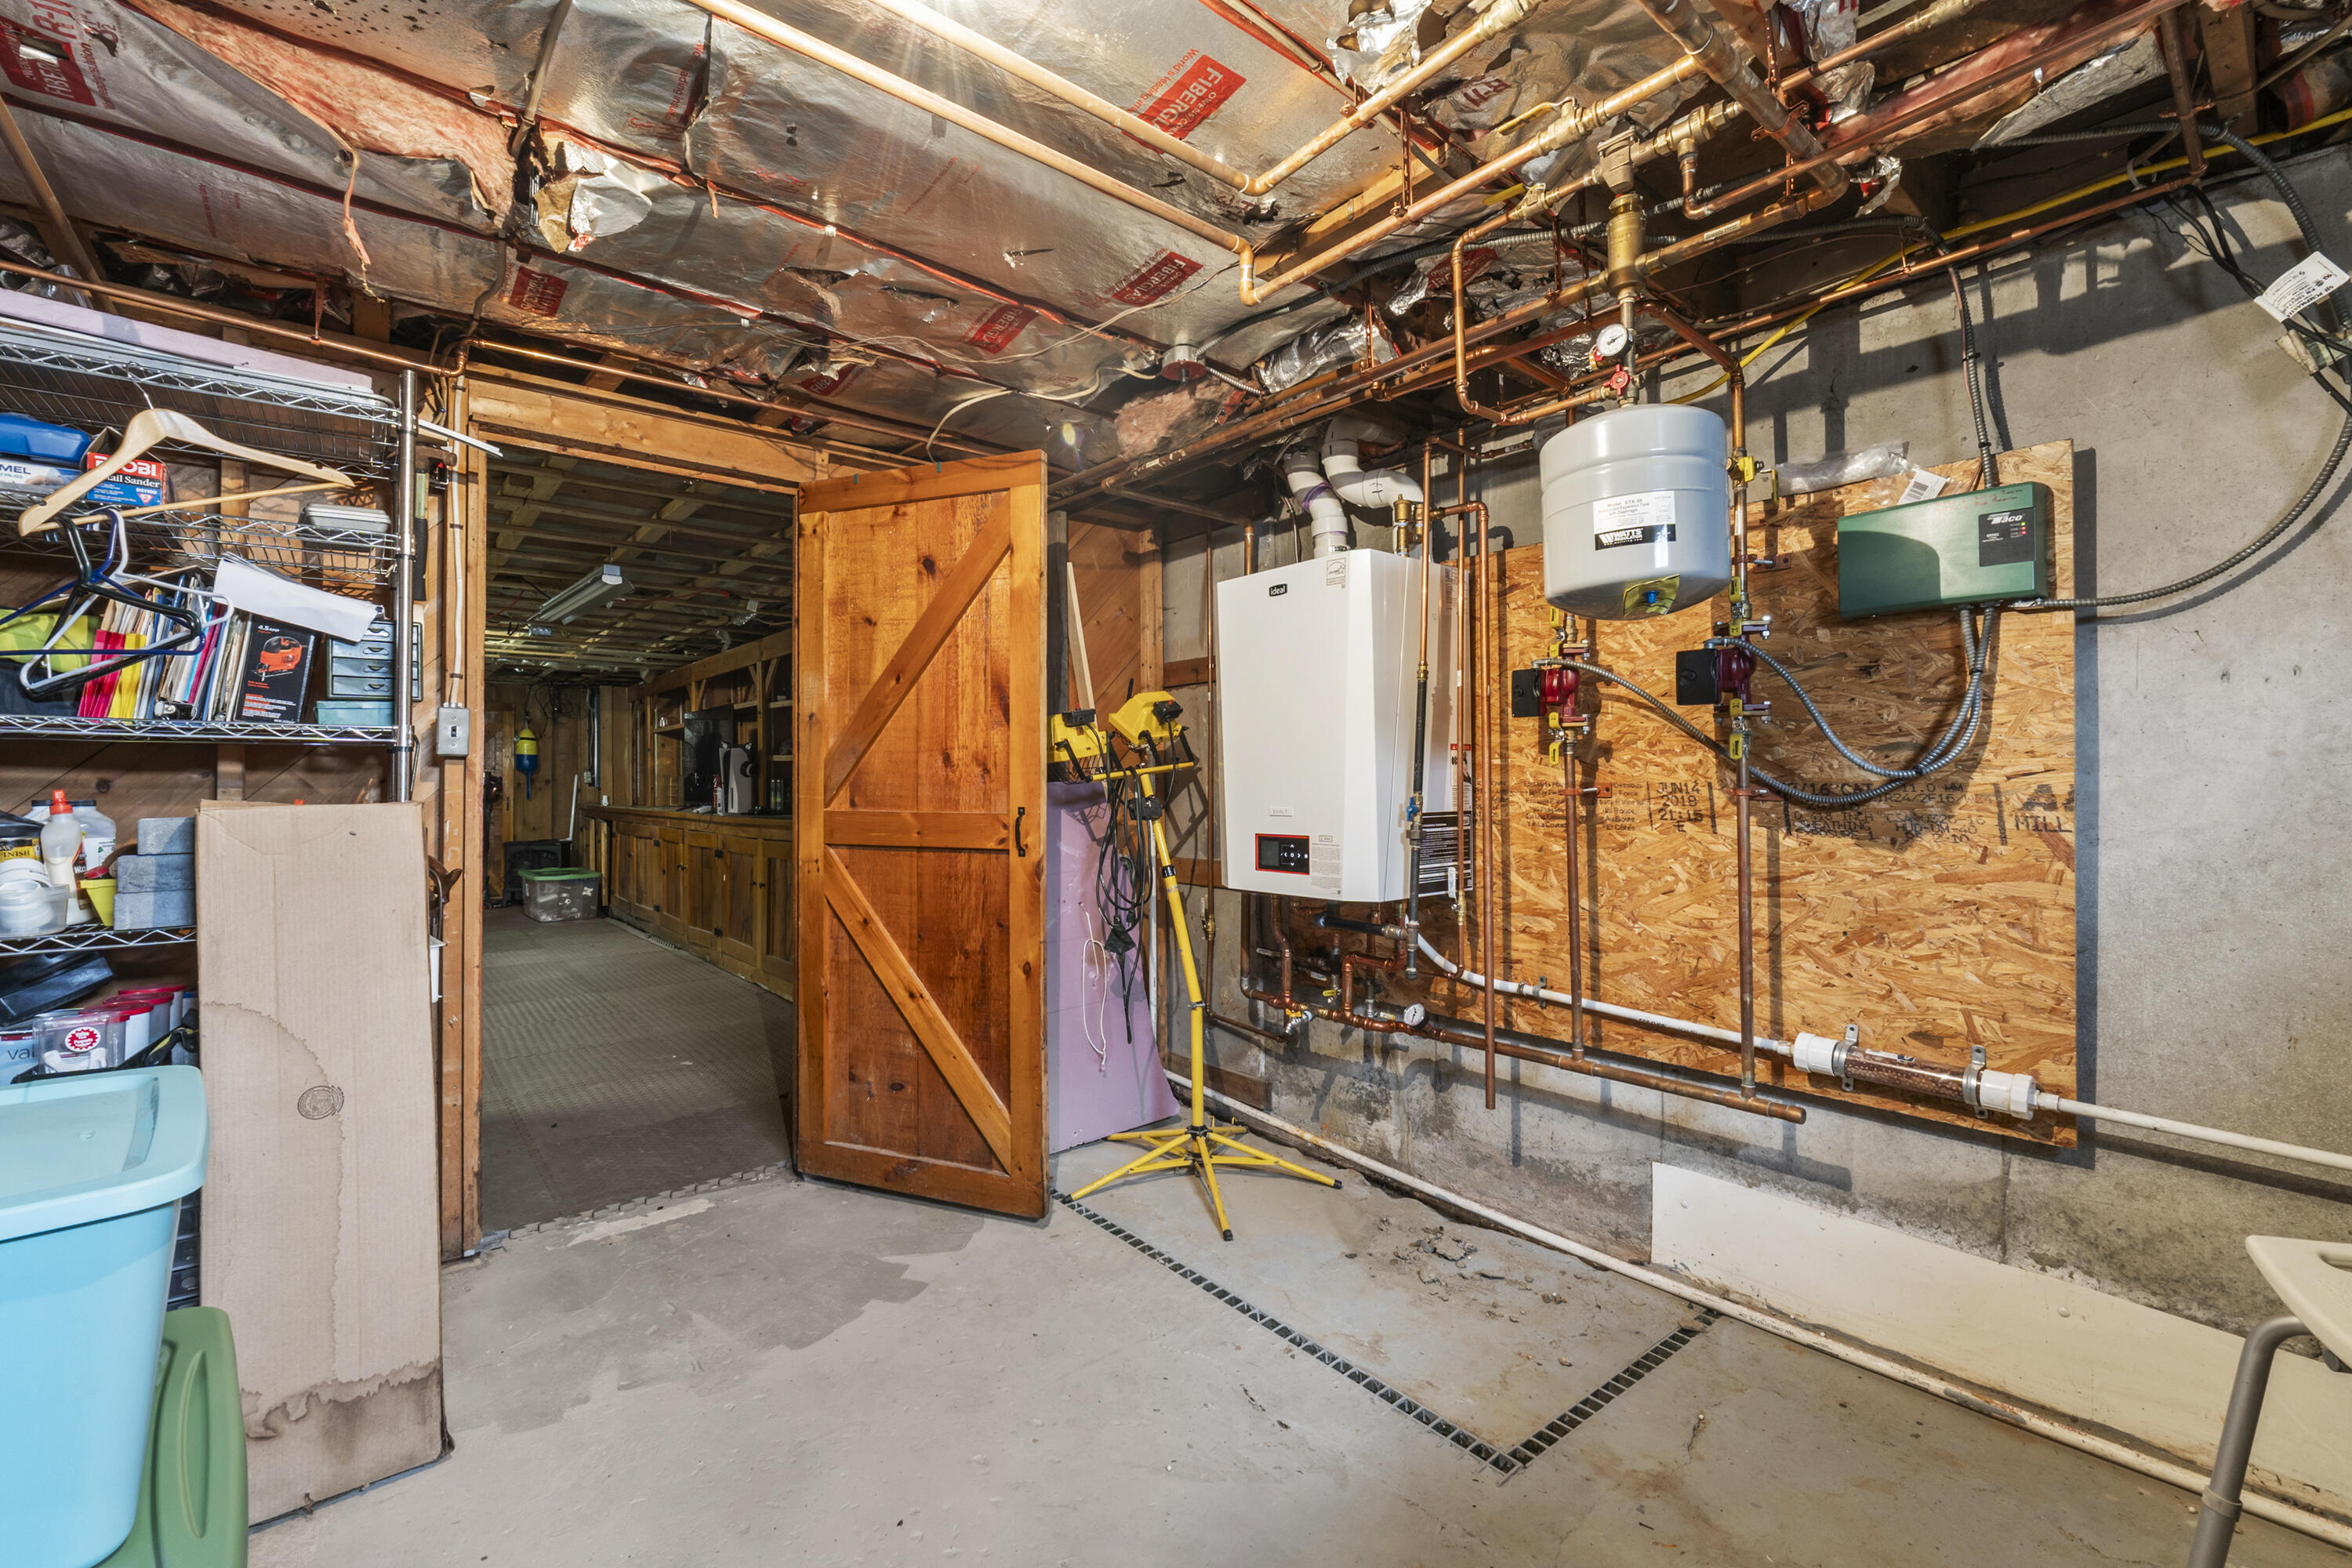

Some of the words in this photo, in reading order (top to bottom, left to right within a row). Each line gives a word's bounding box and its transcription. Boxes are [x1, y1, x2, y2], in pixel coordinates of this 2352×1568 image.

[1167, 48, 1200, 77] World's
[37, 58, 74, 100] FIBER
[1139, 75, 1171, 102] leading
[1153, 67, 1224, 129] FIBERGL
[1167, 92, 1217, 135] OWENS/CORN
[1123, 259, 1187, 302] FIBERGLAS
[94, 455, 156, 477] ROBI
[125, 475, 160, 488] Sander
[1614, 528, 1642, 537] WATTS
[1270, 585, 1285, 596] ideal
[1661, 795, 1698, 807] 2018
[1658, 809, 1704, 822] 21:15
